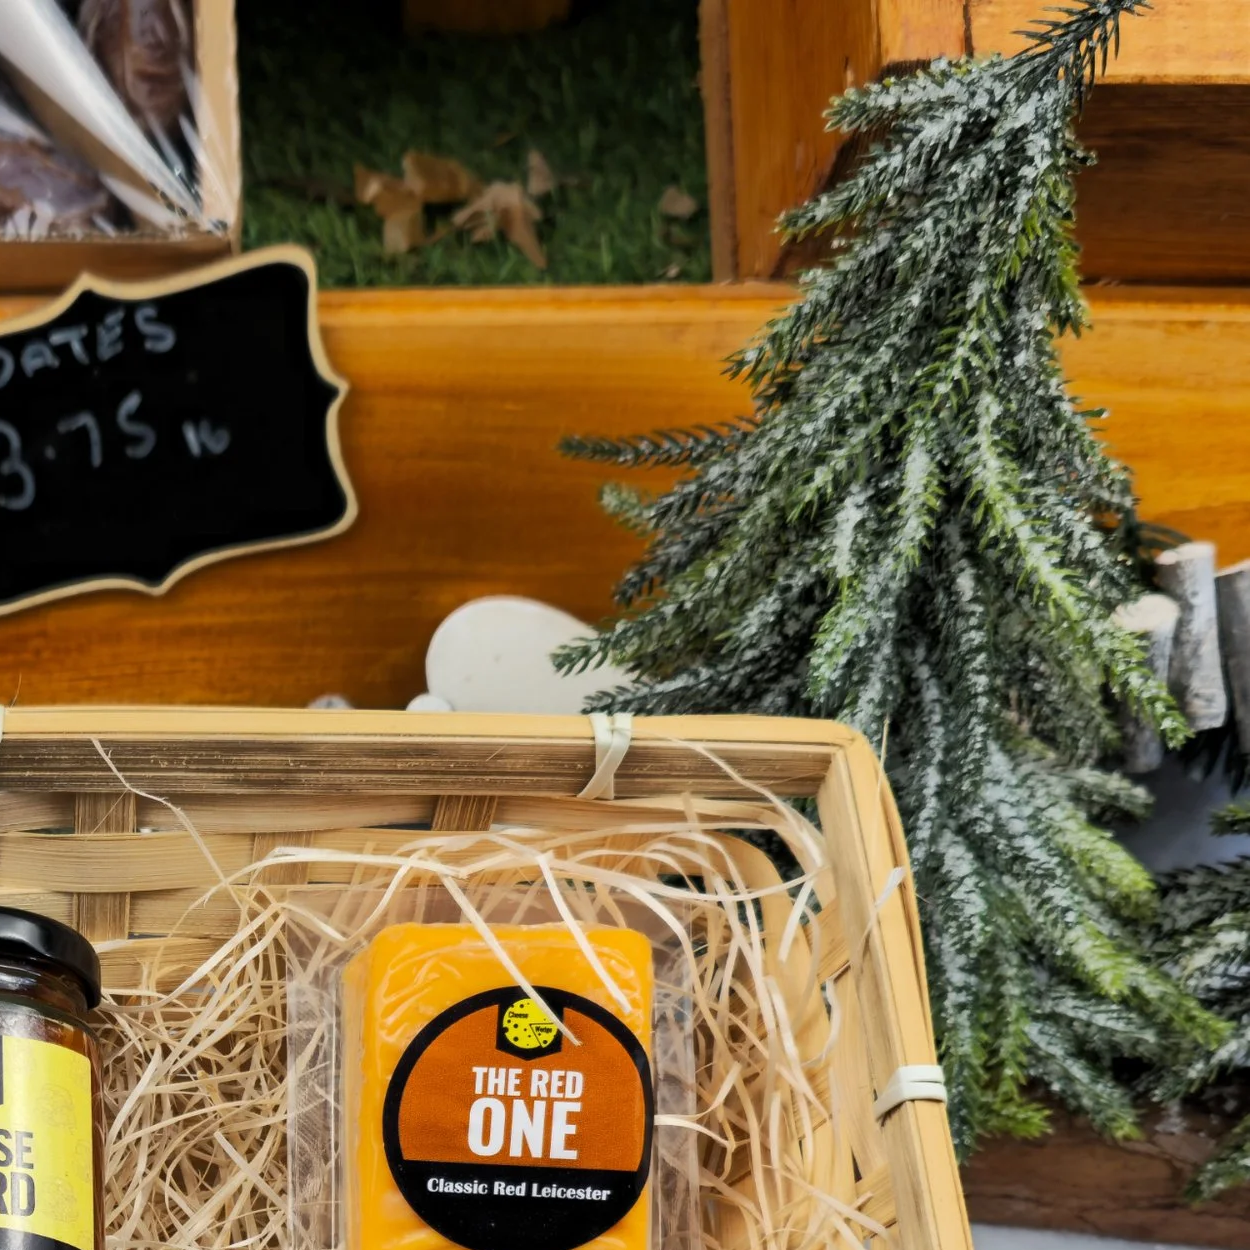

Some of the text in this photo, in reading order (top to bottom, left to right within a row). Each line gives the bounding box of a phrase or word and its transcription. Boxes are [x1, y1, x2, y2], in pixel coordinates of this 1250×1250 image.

[472, 1066, 584, 1099] THE RED
[467, 1097, 582, 1160] ONE
[427, 1177, 611, 1201] Classic Red Leicester
